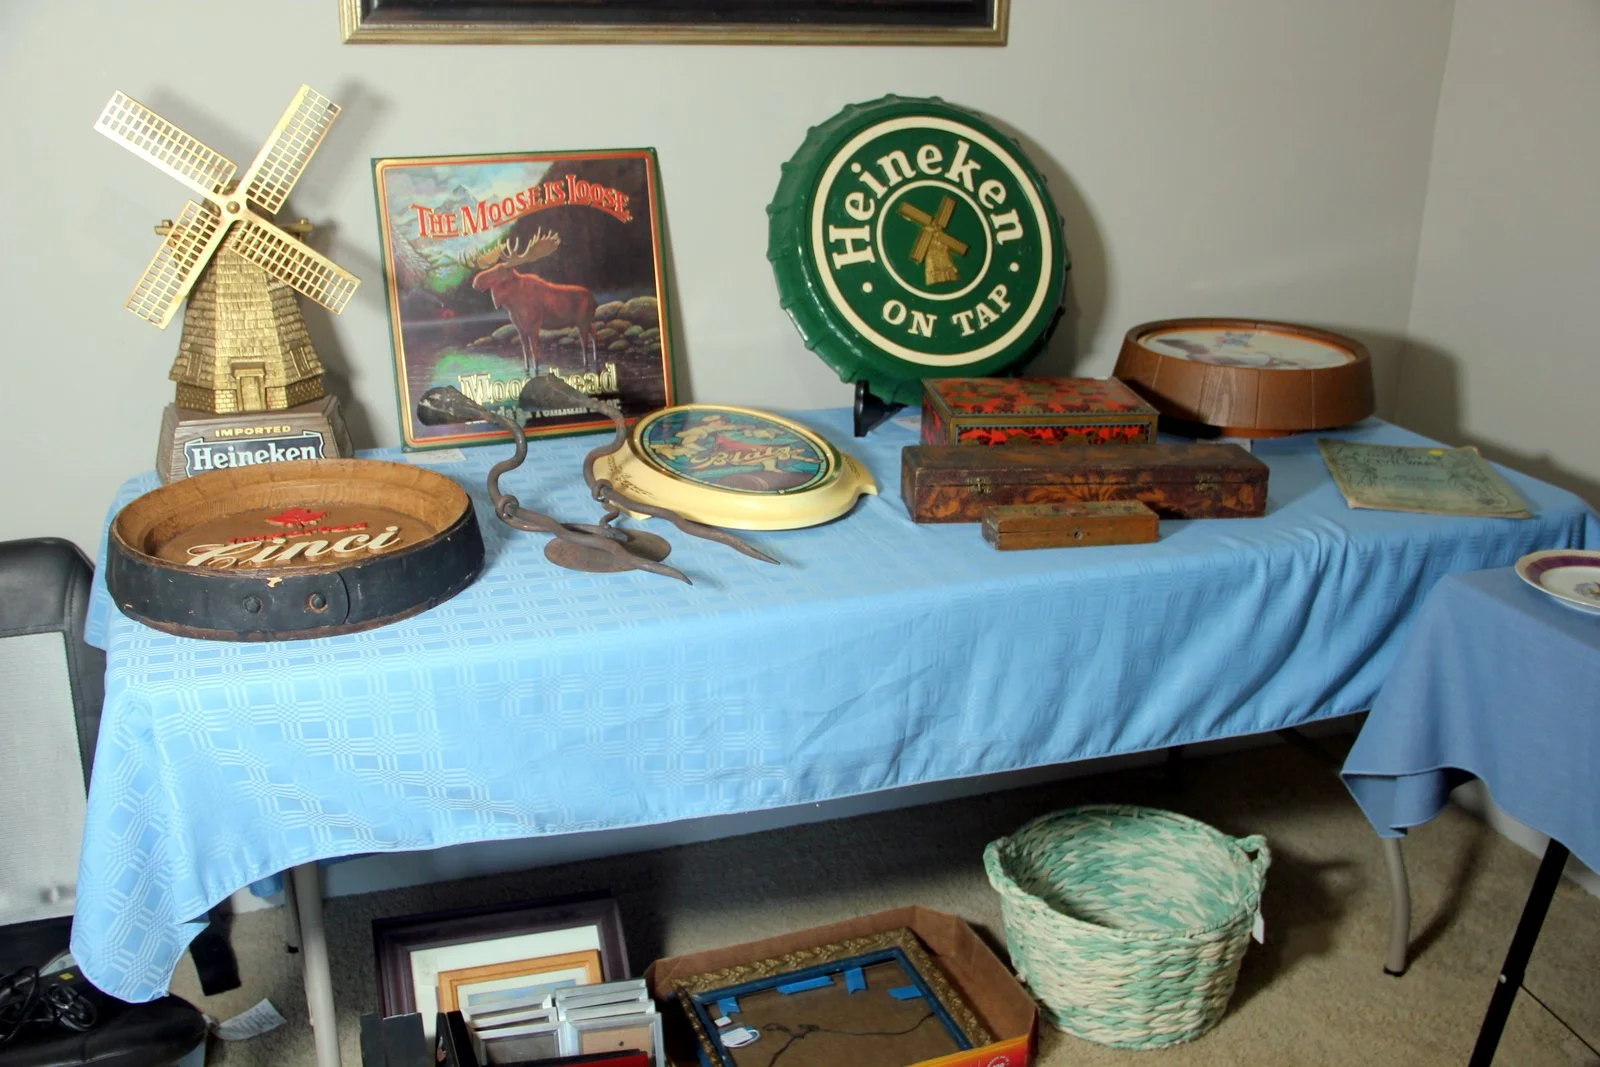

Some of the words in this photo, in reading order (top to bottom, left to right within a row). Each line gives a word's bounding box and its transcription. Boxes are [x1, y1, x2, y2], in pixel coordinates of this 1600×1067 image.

[543, 181, 566, 204] IS
[828, 140, 1024, 270] Heineken
[882, 299, 937, 338] ON
[952, 283, 1011, 337] TAP
[215, 425, 292, 437] IMPORTED
[191, 443, 316, 471] Heineken
